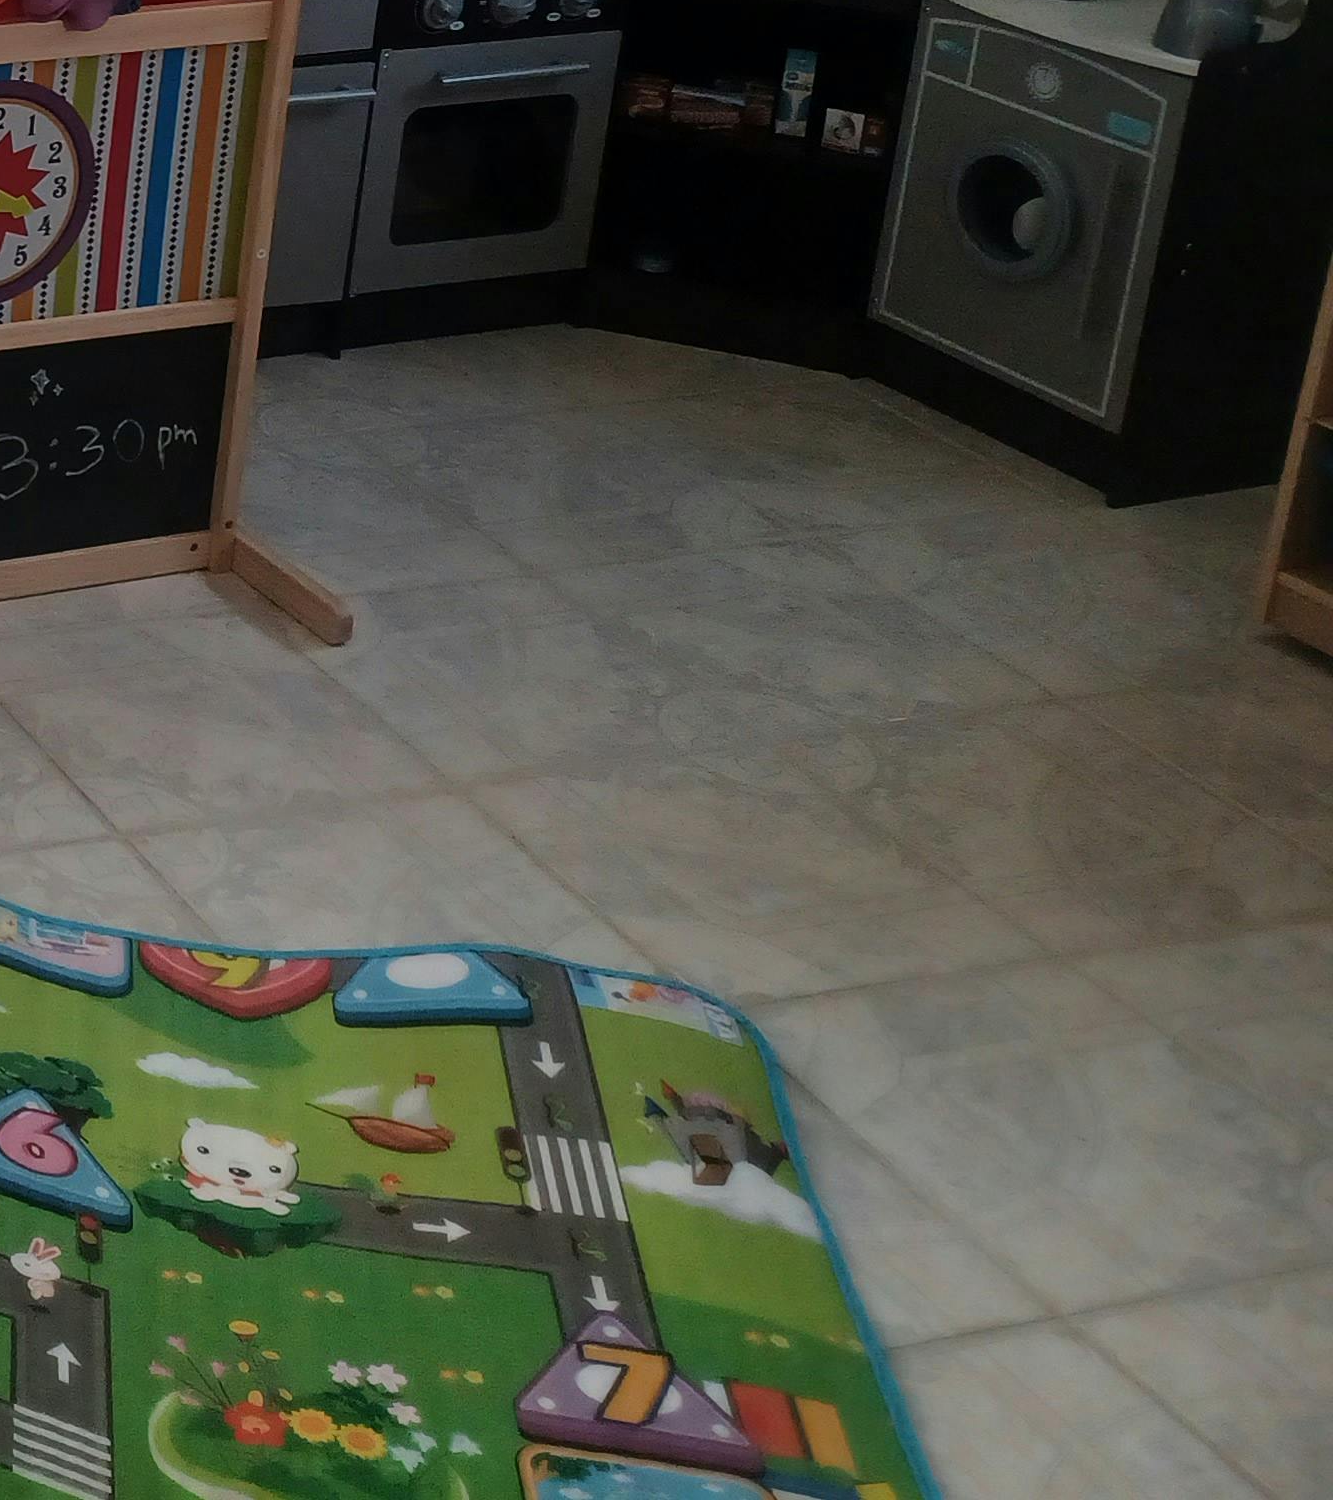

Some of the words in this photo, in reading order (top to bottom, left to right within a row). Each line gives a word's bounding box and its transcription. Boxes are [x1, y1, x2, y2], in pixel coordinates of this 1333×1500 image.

[27, 114, 37, 136] 1
[48, 141, 63, 164] 2
[53, 176, 67, 198] 3
[37, 215, 52, 236] 4
[14, 244, 28, 266] 5
[575, 1340, 675, 1427] 7
